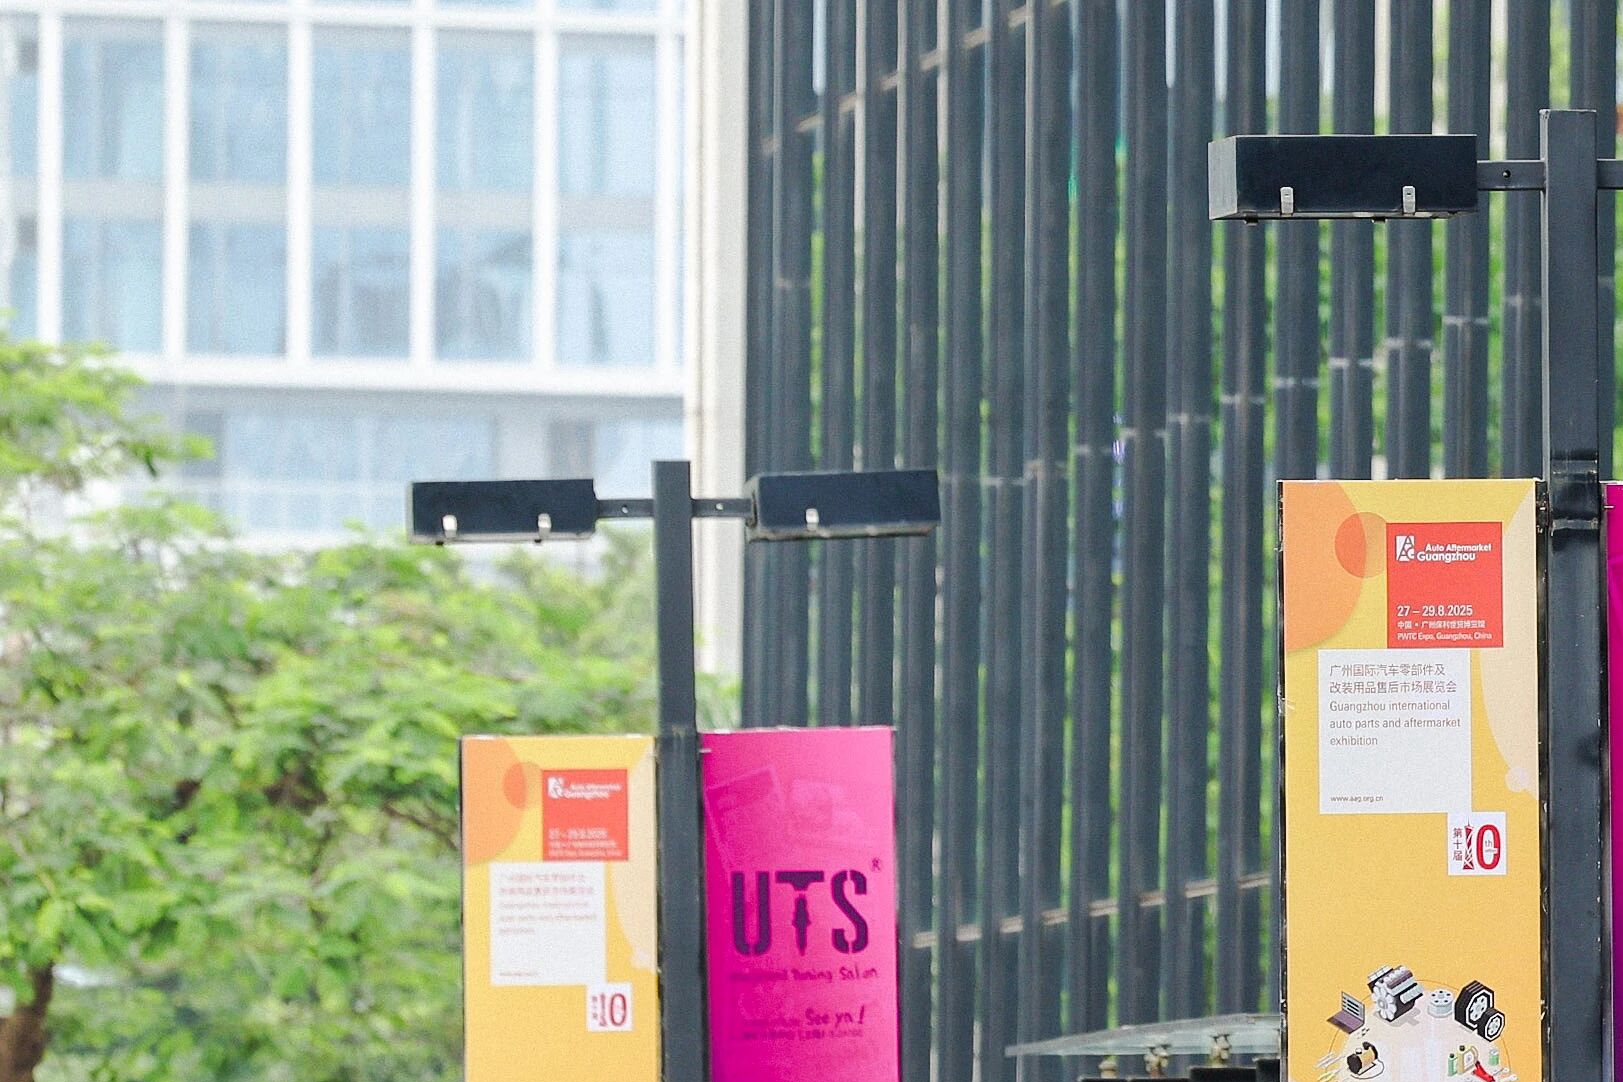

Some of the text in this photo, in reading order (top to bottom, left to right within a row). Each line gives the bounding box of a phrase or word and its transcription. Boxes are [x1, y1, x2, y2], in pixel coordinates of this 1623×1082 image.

[1417, 552, 1475, 563] Guangzhou
[1397, 606, 1410, 616] 27
[1422, 605, 1473, 616] 29.8.2025
[1330, 664, 1446, 676] 广州国际汽车零部件及
[1330, 681, 1457, 693] 改装用品售后市场展览会
[1330, 700, 1449, 713] Guangzhou international
[1330, 718, 1461, 729] auto parts and aftermarket
[1330, 736, 1377, 745] exhibition
[732, 870, 868, 956] UTS
